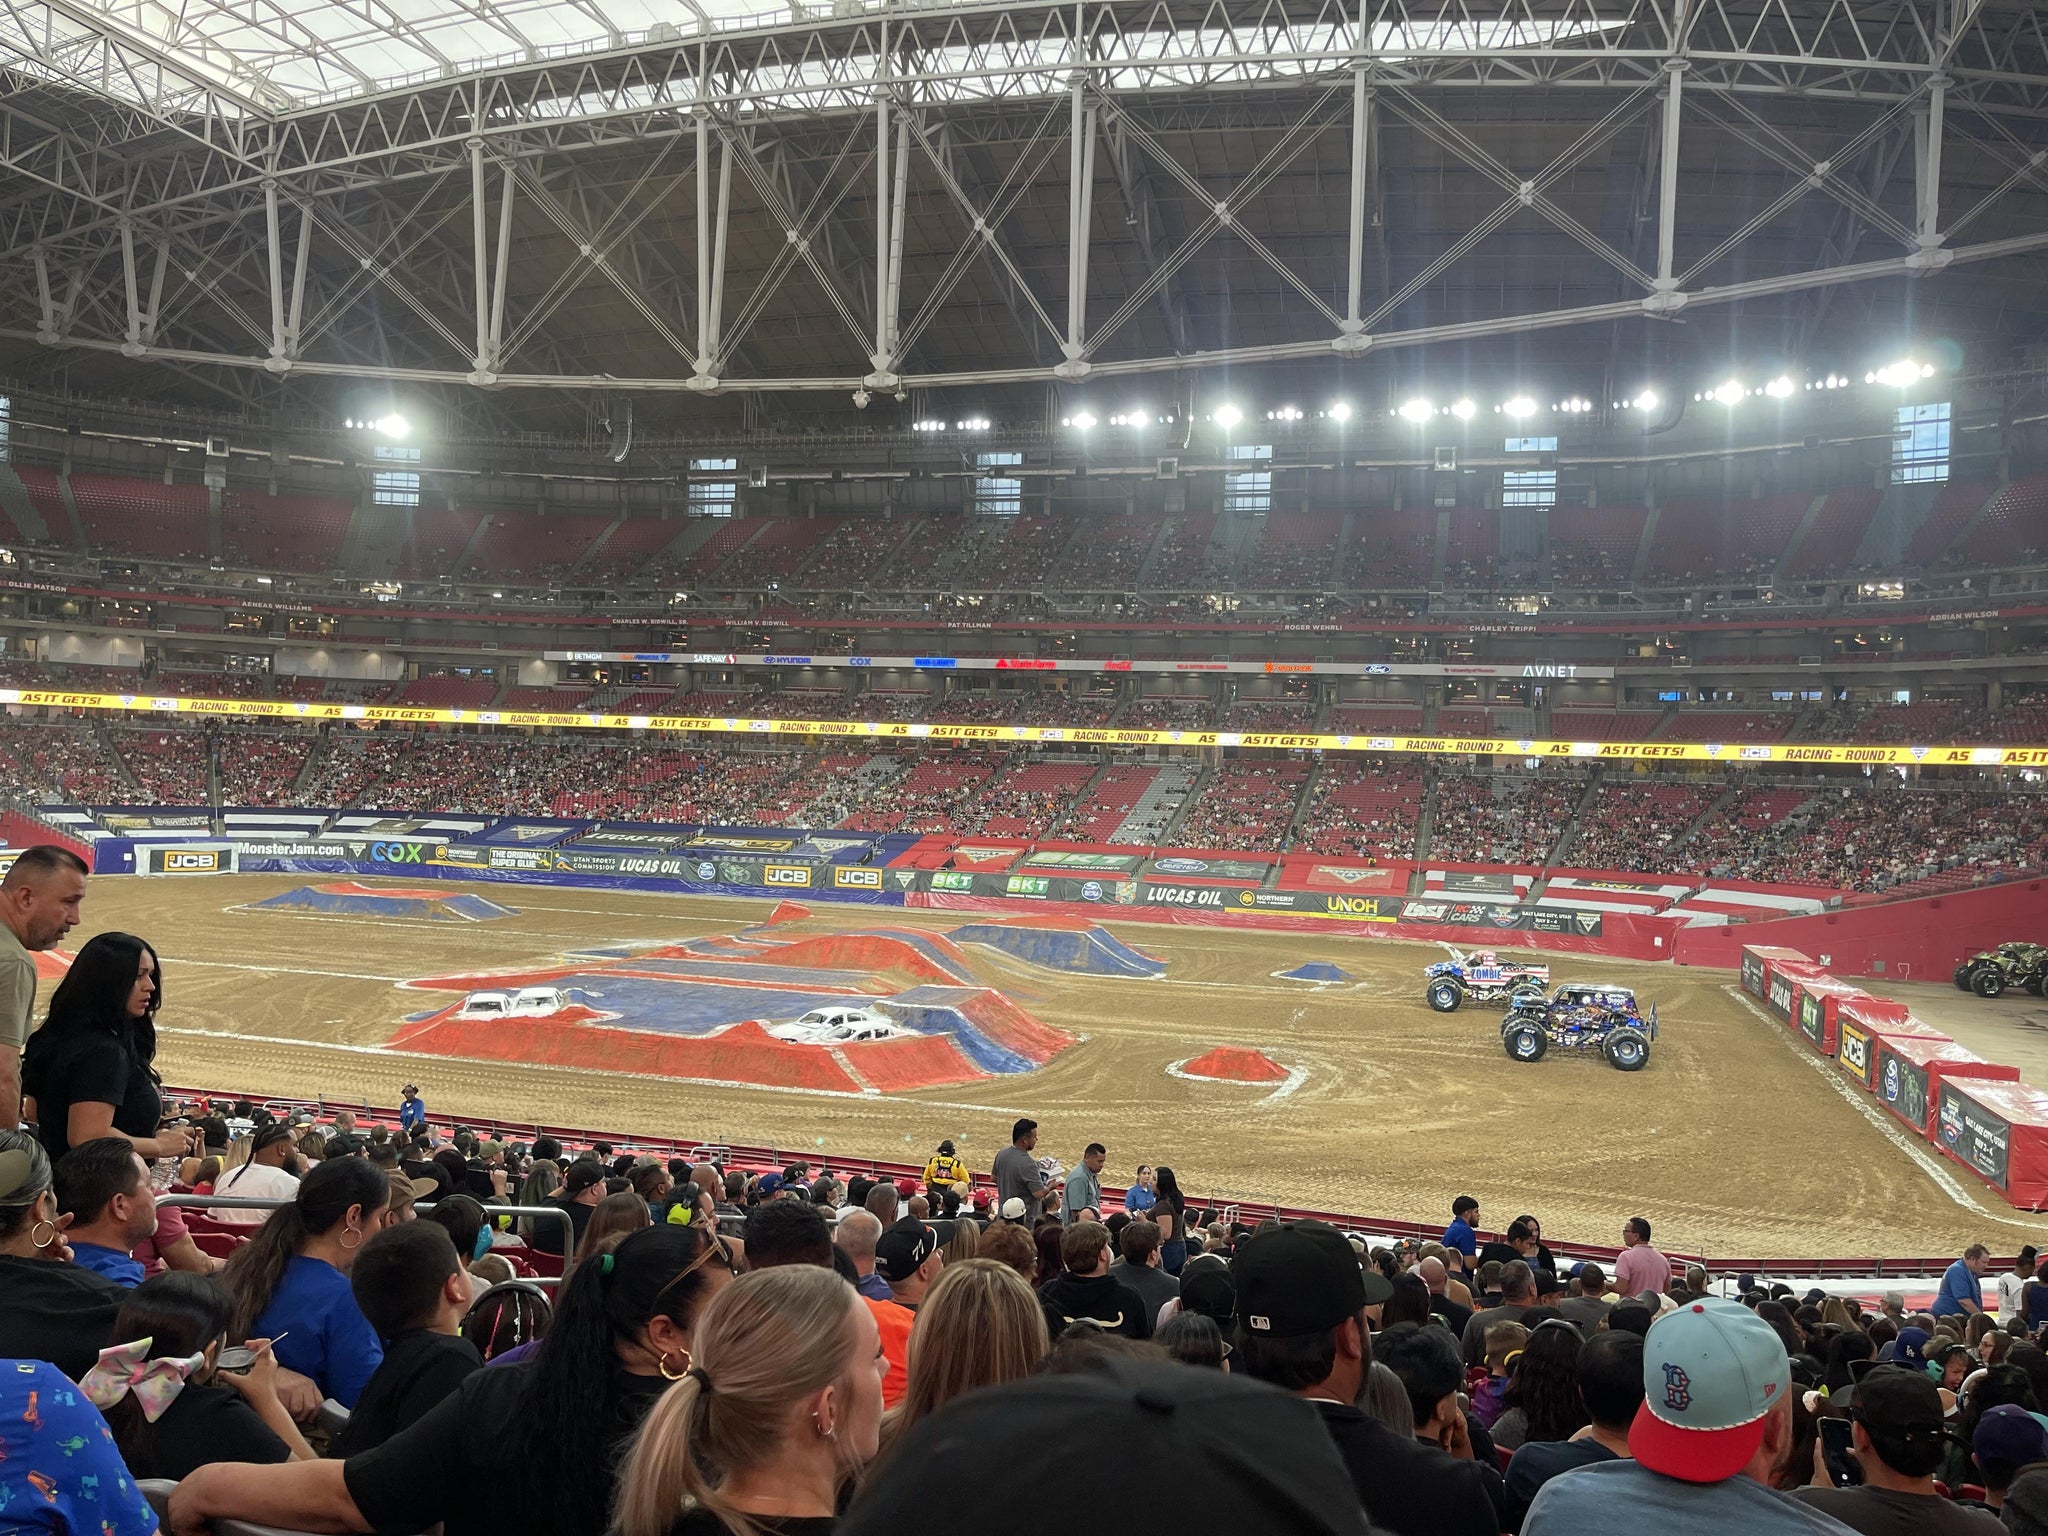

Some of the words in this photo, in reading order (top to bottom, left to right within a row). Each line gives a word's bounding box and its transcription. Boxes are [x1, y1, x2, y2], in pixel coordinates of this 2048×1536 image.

[8, 581, 32, 589] OLLIE
[34, 584, 67, 593] MATSON
[241, 601, 273, 609] AENEAS
[275, 604, 312, 612] WILLIAMS
[1930, 613, 1962, 621] ADRIAN
[1964, 611, 1999, 619] WILSON
[694, 655, 727, 663] SAFEWAY
[849, 657, 872, 666] COX
[1522, 666, 1576, 677] AVNET
[22, 693, 41, 702] AS
[44, 694, 59, 703] IT
[62, 695, 102, 705] GETS!
[190, 702, 229, 711] RACING
[239, 704, 274, 713] ROUND
[276, 706, 283, 714] 2
[324, 708, 341, 716] AS
[366, 709, 383, 718] AS
[385, 710, 399, 718] IT
[400, 710, 436, 719] GETS!
[510, 715, 540, 724] RACING
[547, 716, 574, 724] ROUND
[614, 718, 629, 726] AS
[650, 719, 664, 727] AS
[680, 720, 711, 728] GETS!
[780, 723, 810, 732] RACING
[819, 724, 848, 733] ROUND
[850, 725, 856, 733] 2
[892, 726, 907, 734] AS
[931, 727, 947, 735] AS
[949, 727, 962, 736] IT
[964, 728, 998, 737] GETS!
[1040, 730, 1063, 738] JCB
[1074, 732, 1108, 741] RACING
[1117, 733, 1149, 741] ROUND
[1151, 734, 1159, 742] 2
[1199, 735, 1216, 743] AS
[1243, 736, 1261, 744] AS
[1263, 737, 1278, 745] IT
[1280, 737, 1319, 746] GETS!
[1367, 739, 1394, 748] JCB
[1406, 741, 1446, 750] RACING
[1456, 741, 1493, 751] ROUND
[1496, 743, 1504, 752] 2
[1550, 745, 1570, 753] AS
[1601, 746, 1621, 754] AS
[1623, 746, 1639, 755] IT
[1641, 746, 1685, 756] GETS!
[1785, 749, 1832, 759] RACING
[1845, 750, 1885, 761] ROUND
[1888, 751, 1896, 761] 2
[1947, 751, 1970, 761] AS
[2004, 752, 2028, 762] AS
[238, 842, 344, 856] MonsterJam.com
[371, 841, 423, 864] COX
[491, 850, 506, 858] THE
[506, 850, 542, 860] ORIGINAL
[168, 855, 214, 868] JCB
[491, 859, 516, 867] SUPER
[517, 860, 537, 868] GLUE
[573, 863, 615, 871] COMMISSION
[619, 858, 659, 873] LUCAS
[768, 869, 808, 883] JCB
[838, 871, 879, 885] JCB
[932, 873, 973, 887] BKT
[1007, 878, 1049, 892] BKT
[1147, 887, 1196, 905] LUCAS
[1256, 894, 1295, 902] NORTHERN
[1327, 896, 1378, 913] UNOH
[1454, 905, 1472, 913] RC
[1450, 913, 1481, 923] CARS
[1470, 968, 1502, 980] ZOMBIE
[1843, 1034, 1864, 1068] JCB
[1662, 1363, 1694, 1411] B
